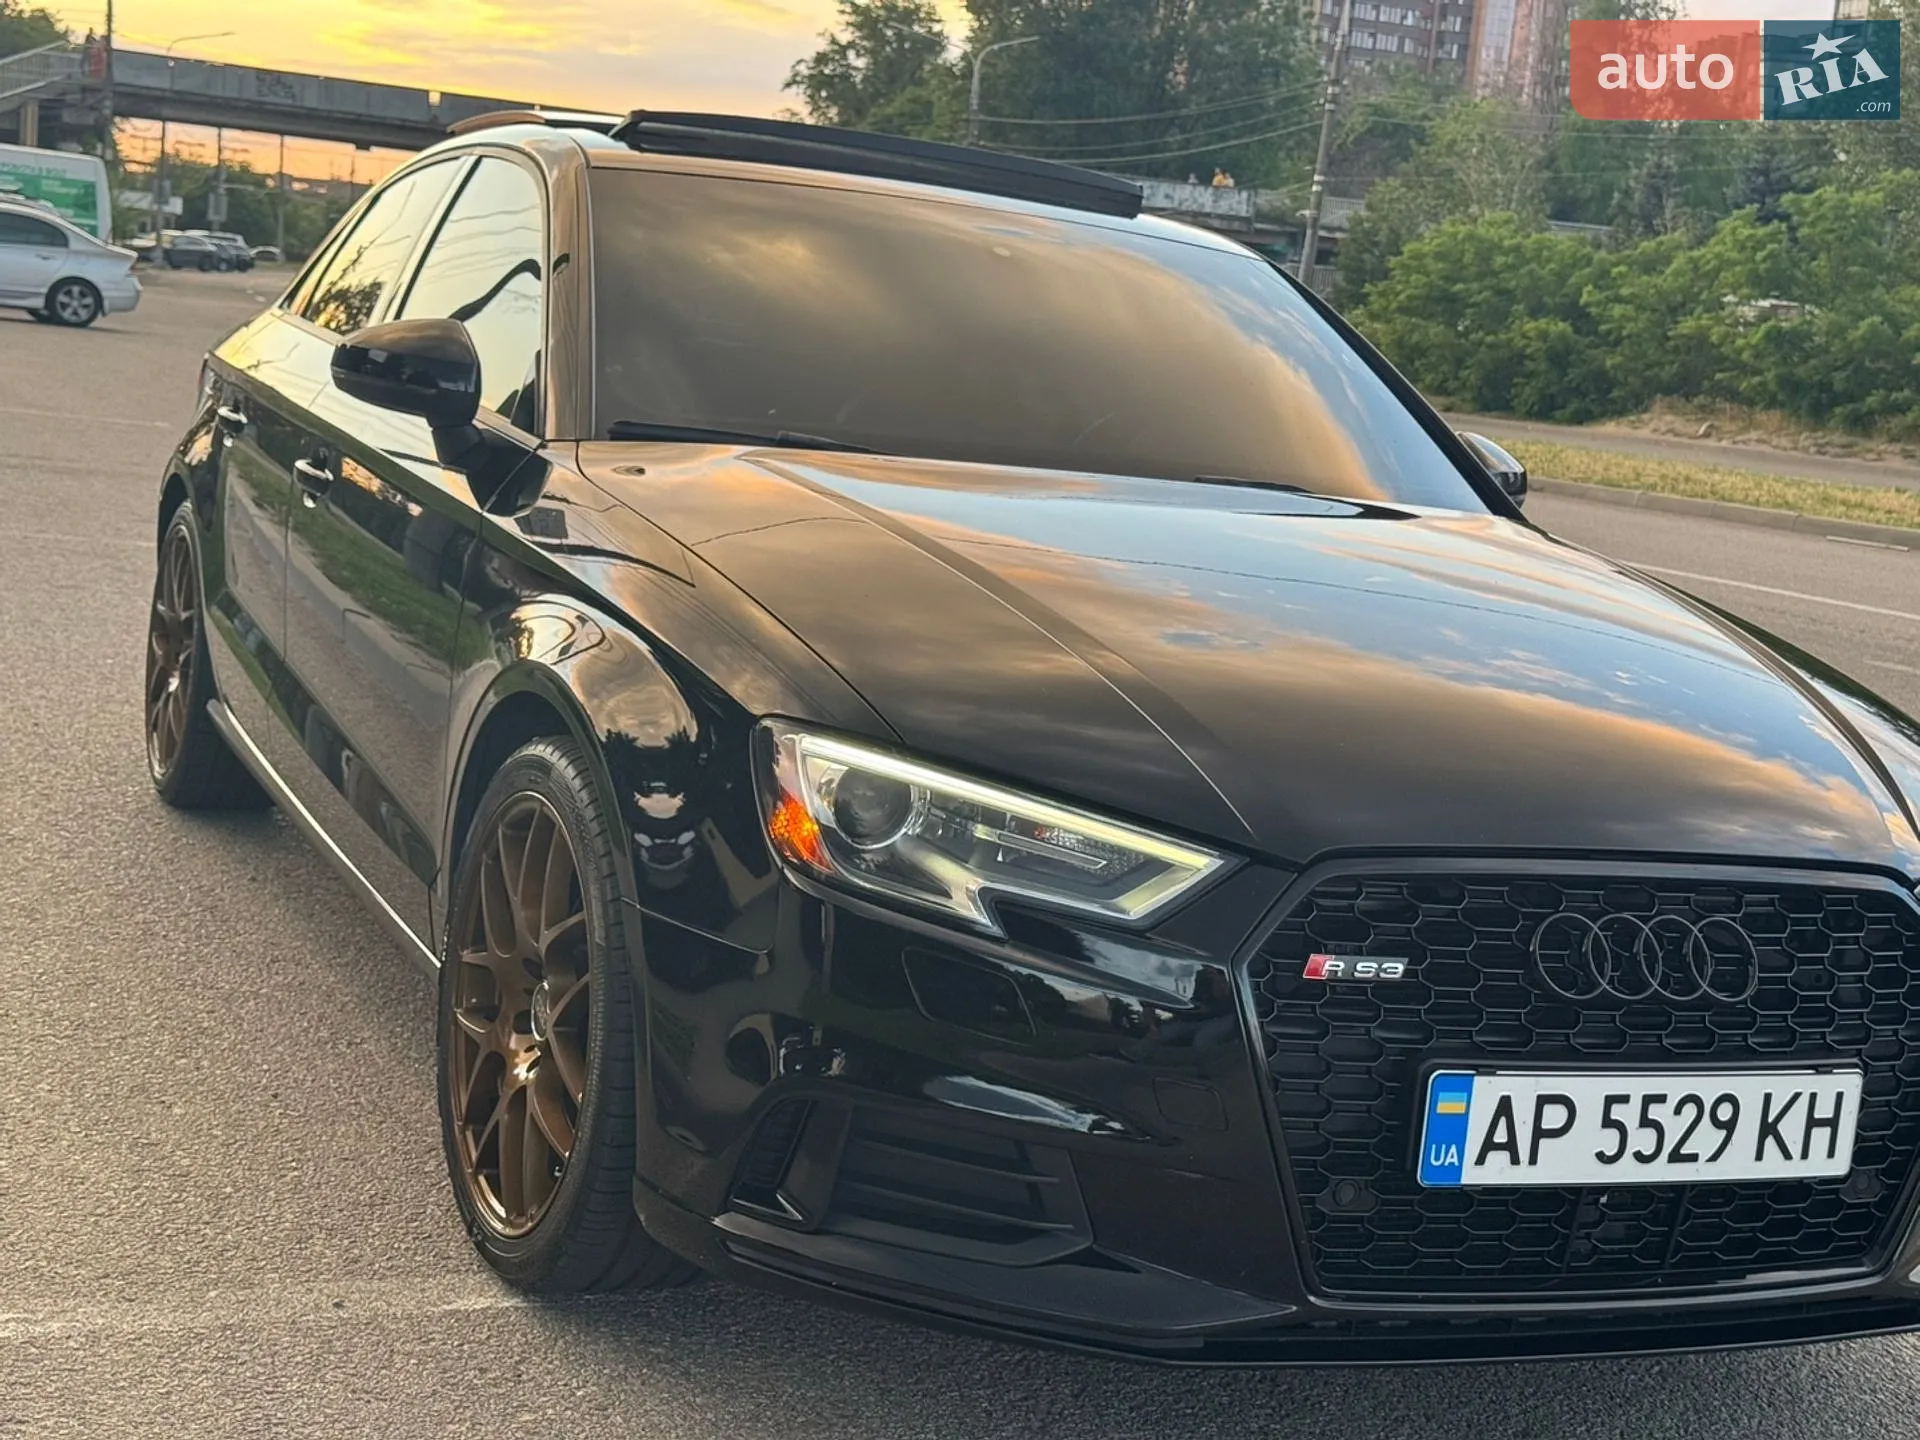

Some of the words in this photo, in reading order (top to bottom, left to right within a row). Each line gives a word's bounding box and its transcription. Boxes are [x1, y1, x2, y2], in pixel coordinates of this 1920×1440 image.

[1474, 1093, 1577, 1166] AP
[1594, 1092, 1741, 1165] 5529
[1754, 1091, 1844, 1162] KH
[1430, 1143, 1460, 1167] UA
